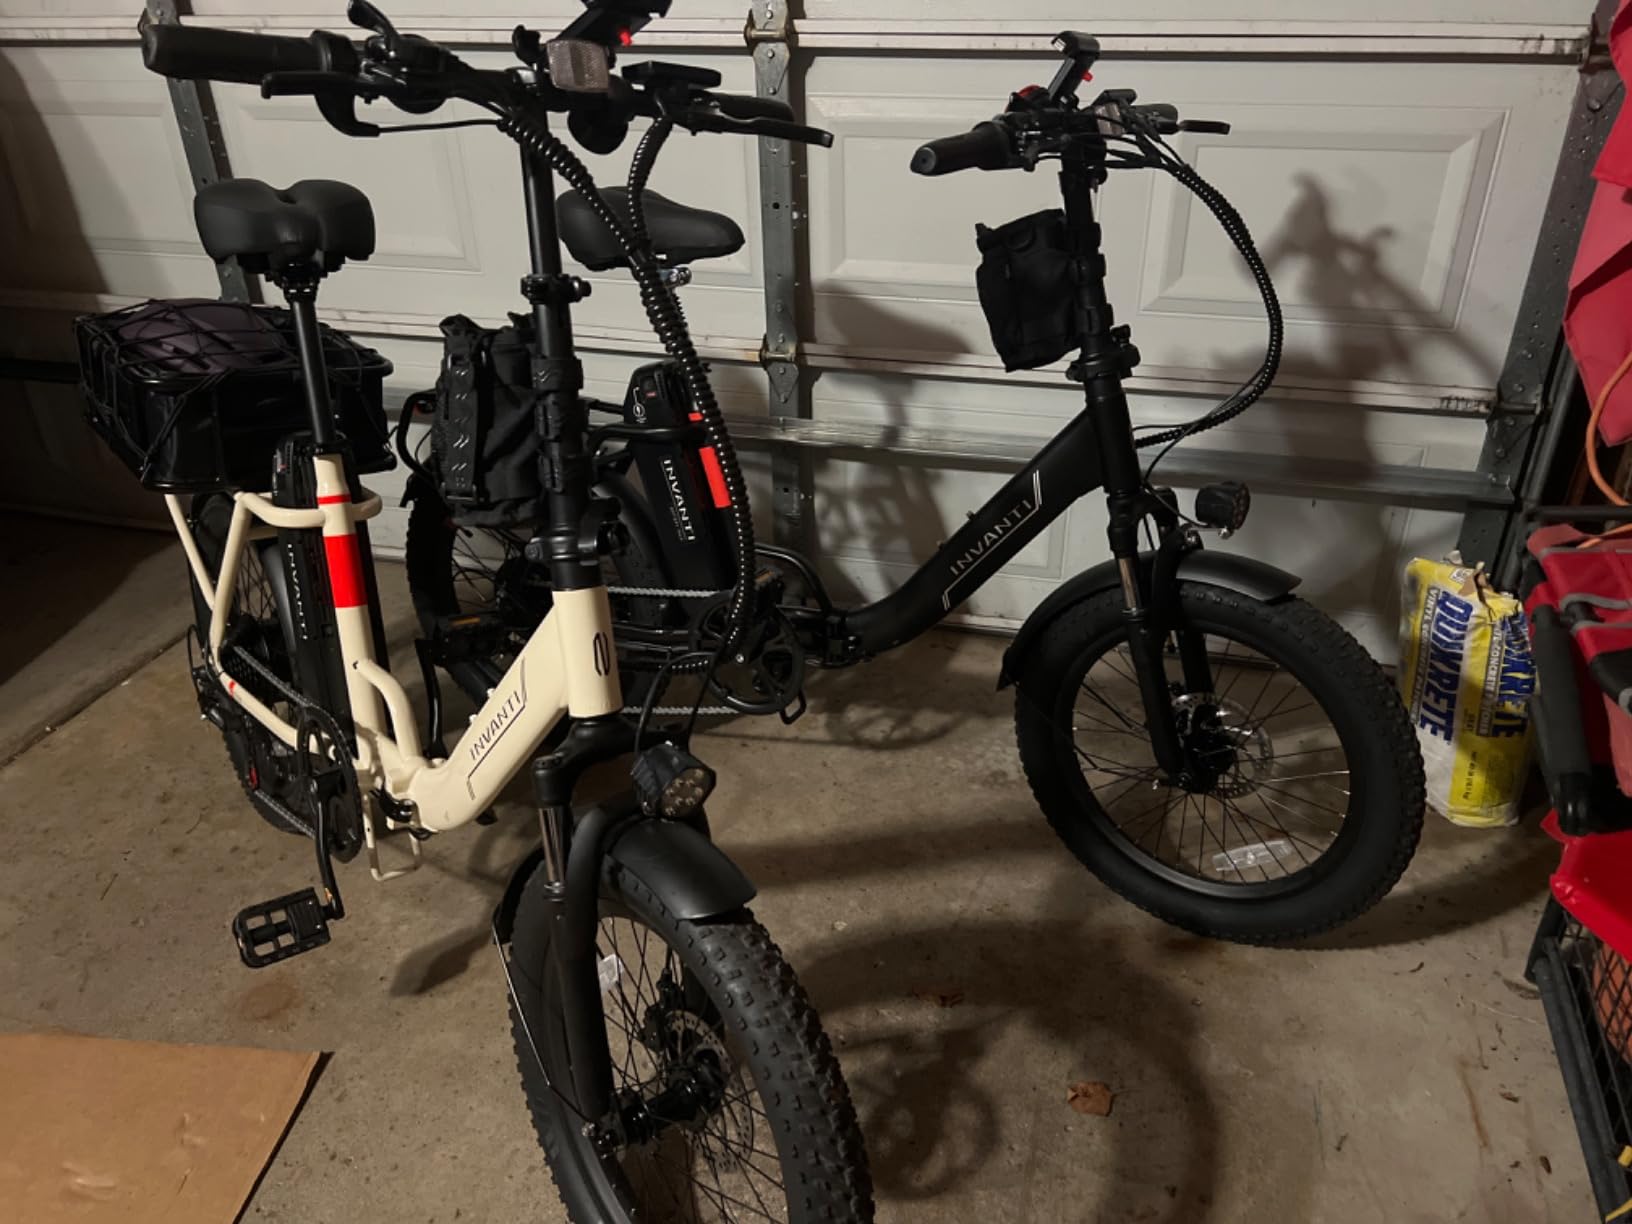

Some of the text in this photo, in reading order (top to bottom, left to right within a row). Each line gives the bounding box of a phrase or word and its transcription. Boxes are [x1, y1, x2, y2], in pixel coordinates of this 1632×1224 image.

[663, 459, 696, 541] INVANTI
[950, 500, 1032, 575] INVANTI
[1421, 590, 1473, 744] QUIKRETE
[470, 690, 521, 761] INVANTI
